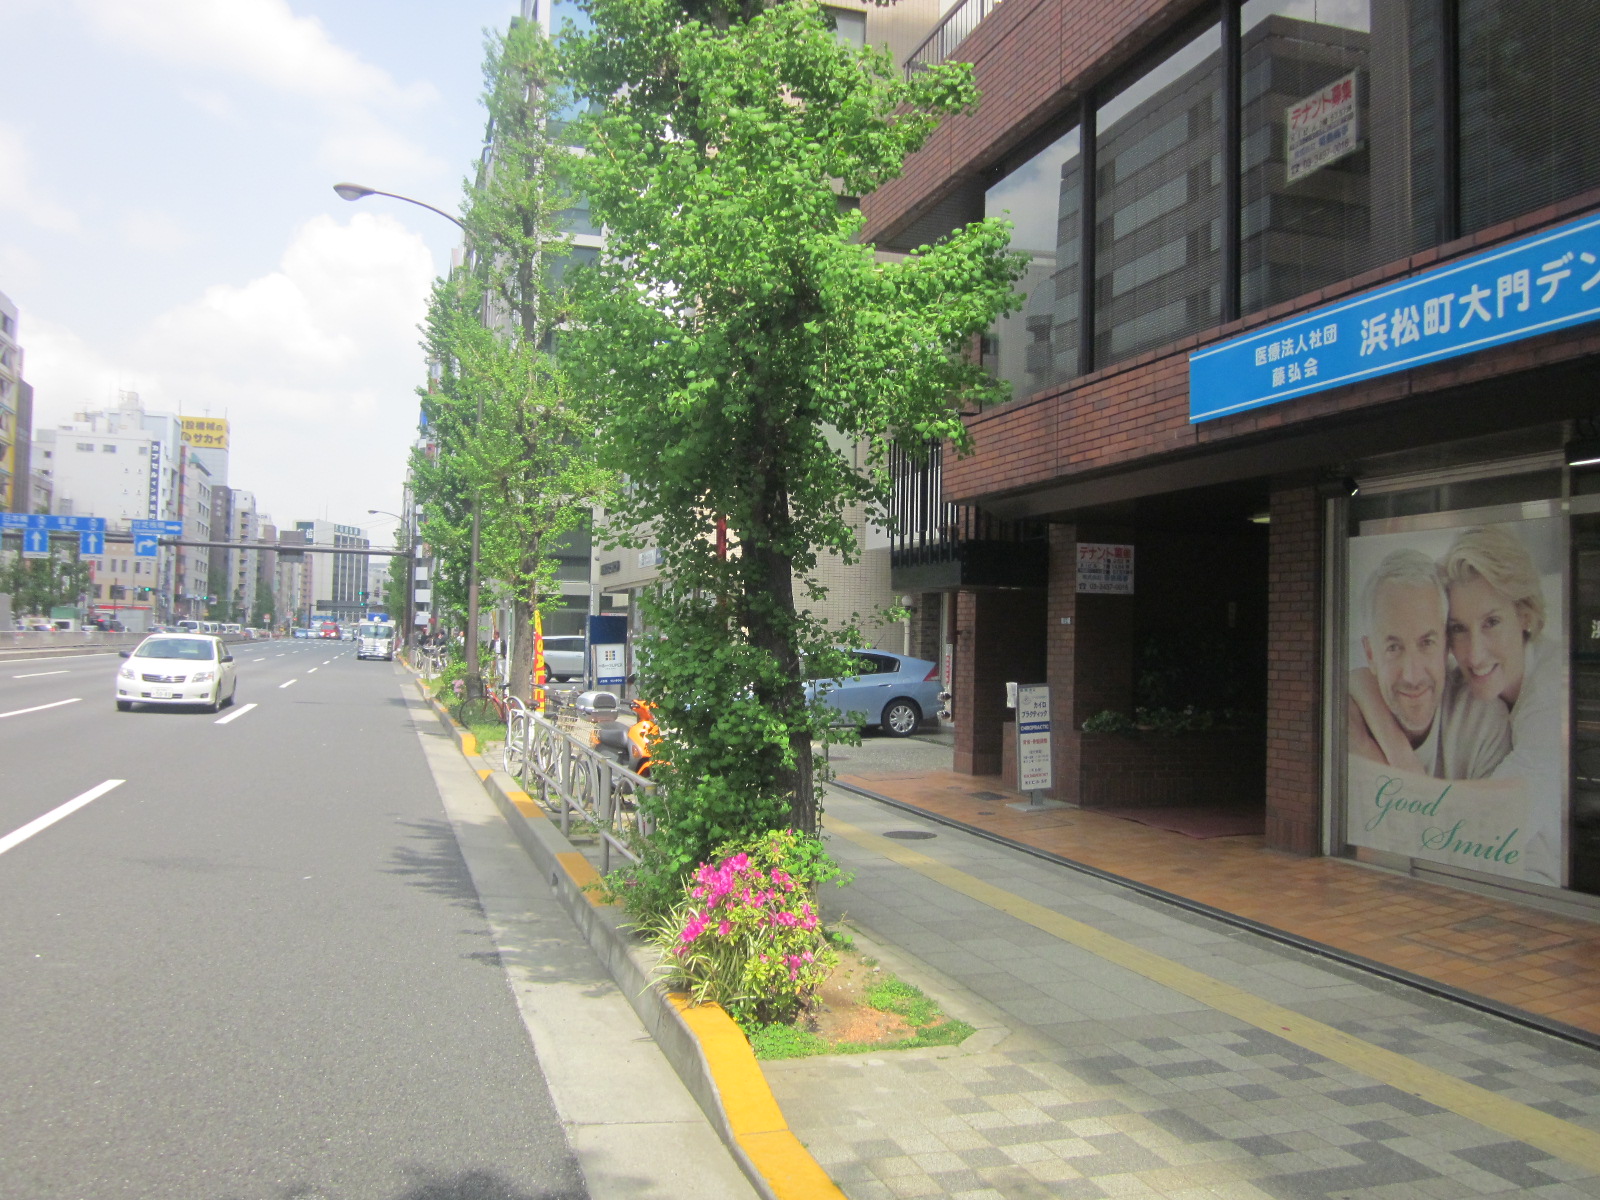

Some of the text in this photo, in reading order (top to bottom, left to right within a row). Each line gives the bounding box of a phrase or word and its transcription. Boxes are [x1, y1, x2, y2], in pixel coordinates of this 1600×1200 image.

[1255, 323, 1338, 366] 医療法人社団
[1272, 357, 1318, 388] 藤弘会
[1020, 723, 1049, 732] CHIROPRACTIC
[1364, 775, 1452, 832] Good
[1422, 819, 1520, 865] Smile
